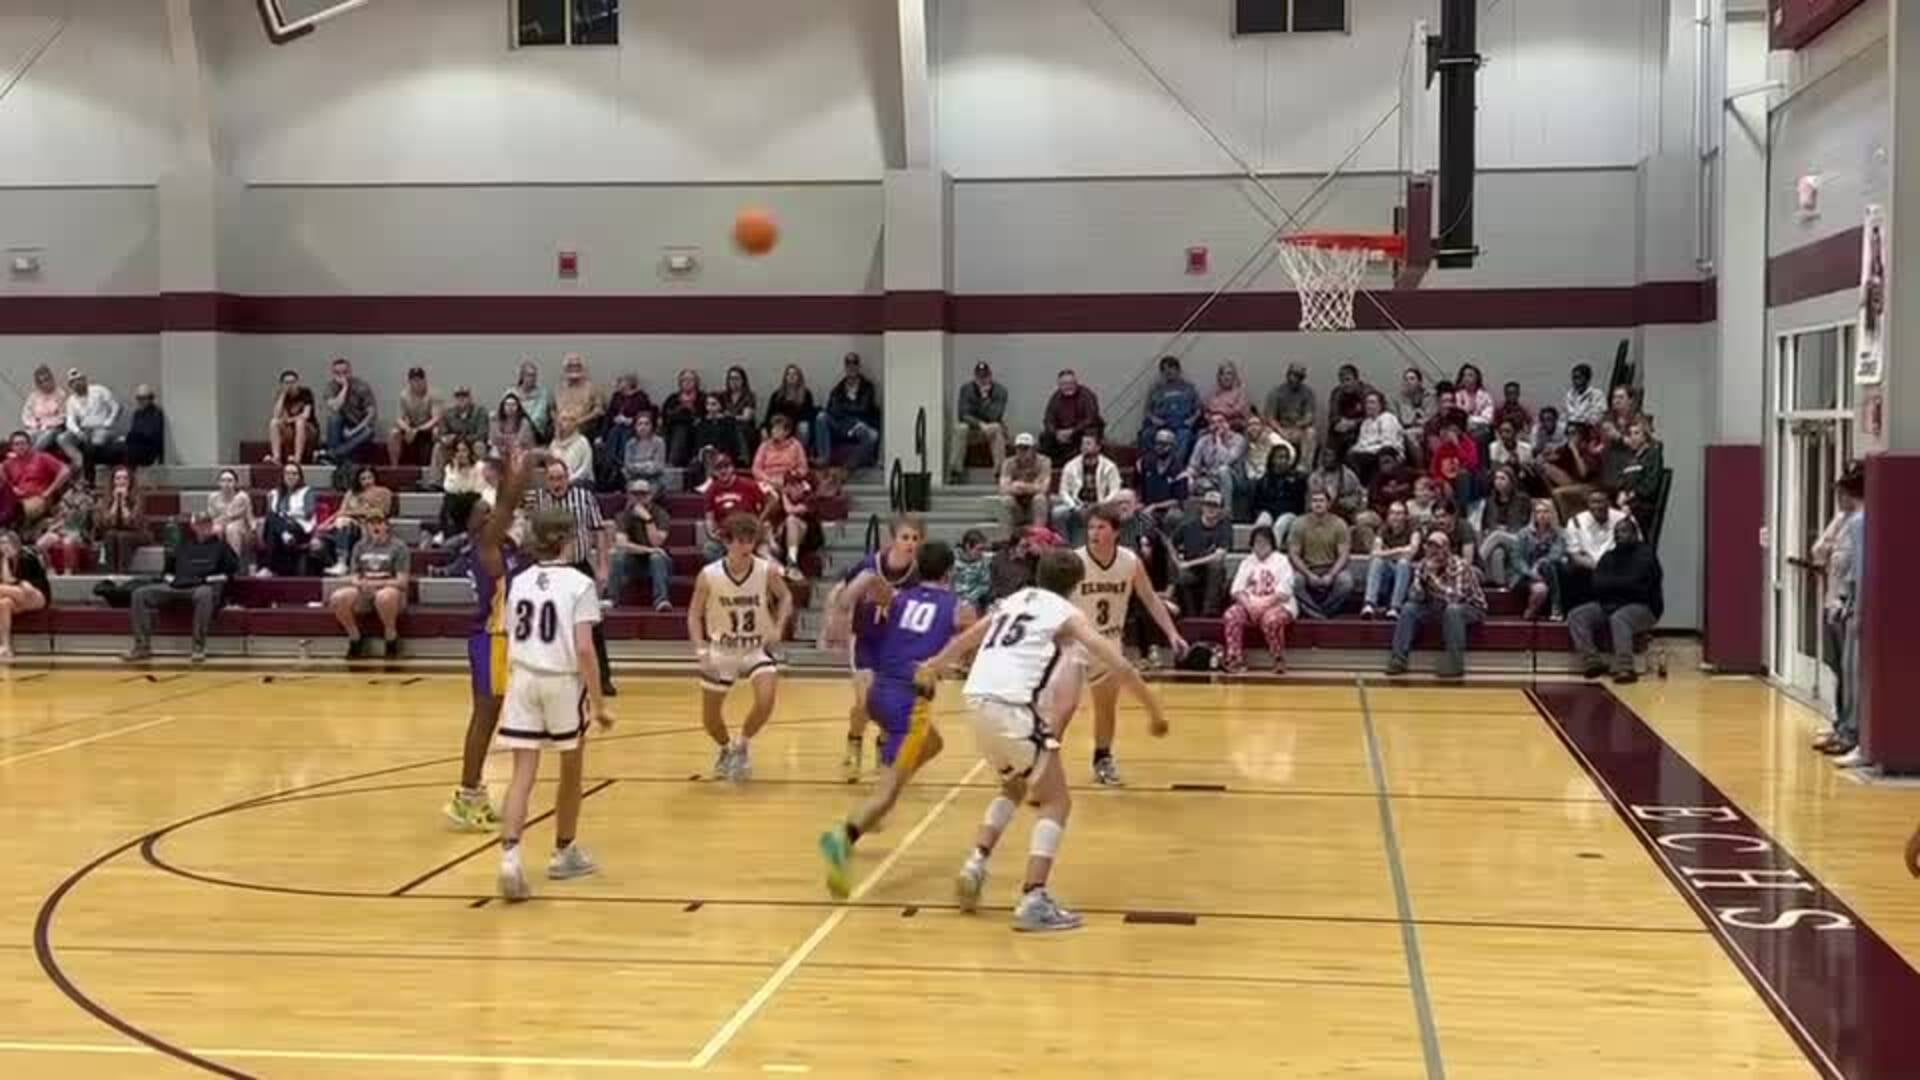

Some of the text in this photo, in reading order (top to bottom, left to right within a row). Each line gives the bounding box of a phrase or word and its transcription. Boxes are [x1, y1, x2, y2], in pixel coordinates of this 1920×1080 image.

[515, 598, 558, 643] 30
[899, 599, 937, 632] 10
[1096, 598, 1110, 626] 3
[984, 613, 1036, 648] 15
[1629, 804, 1857, 931] ECHS
